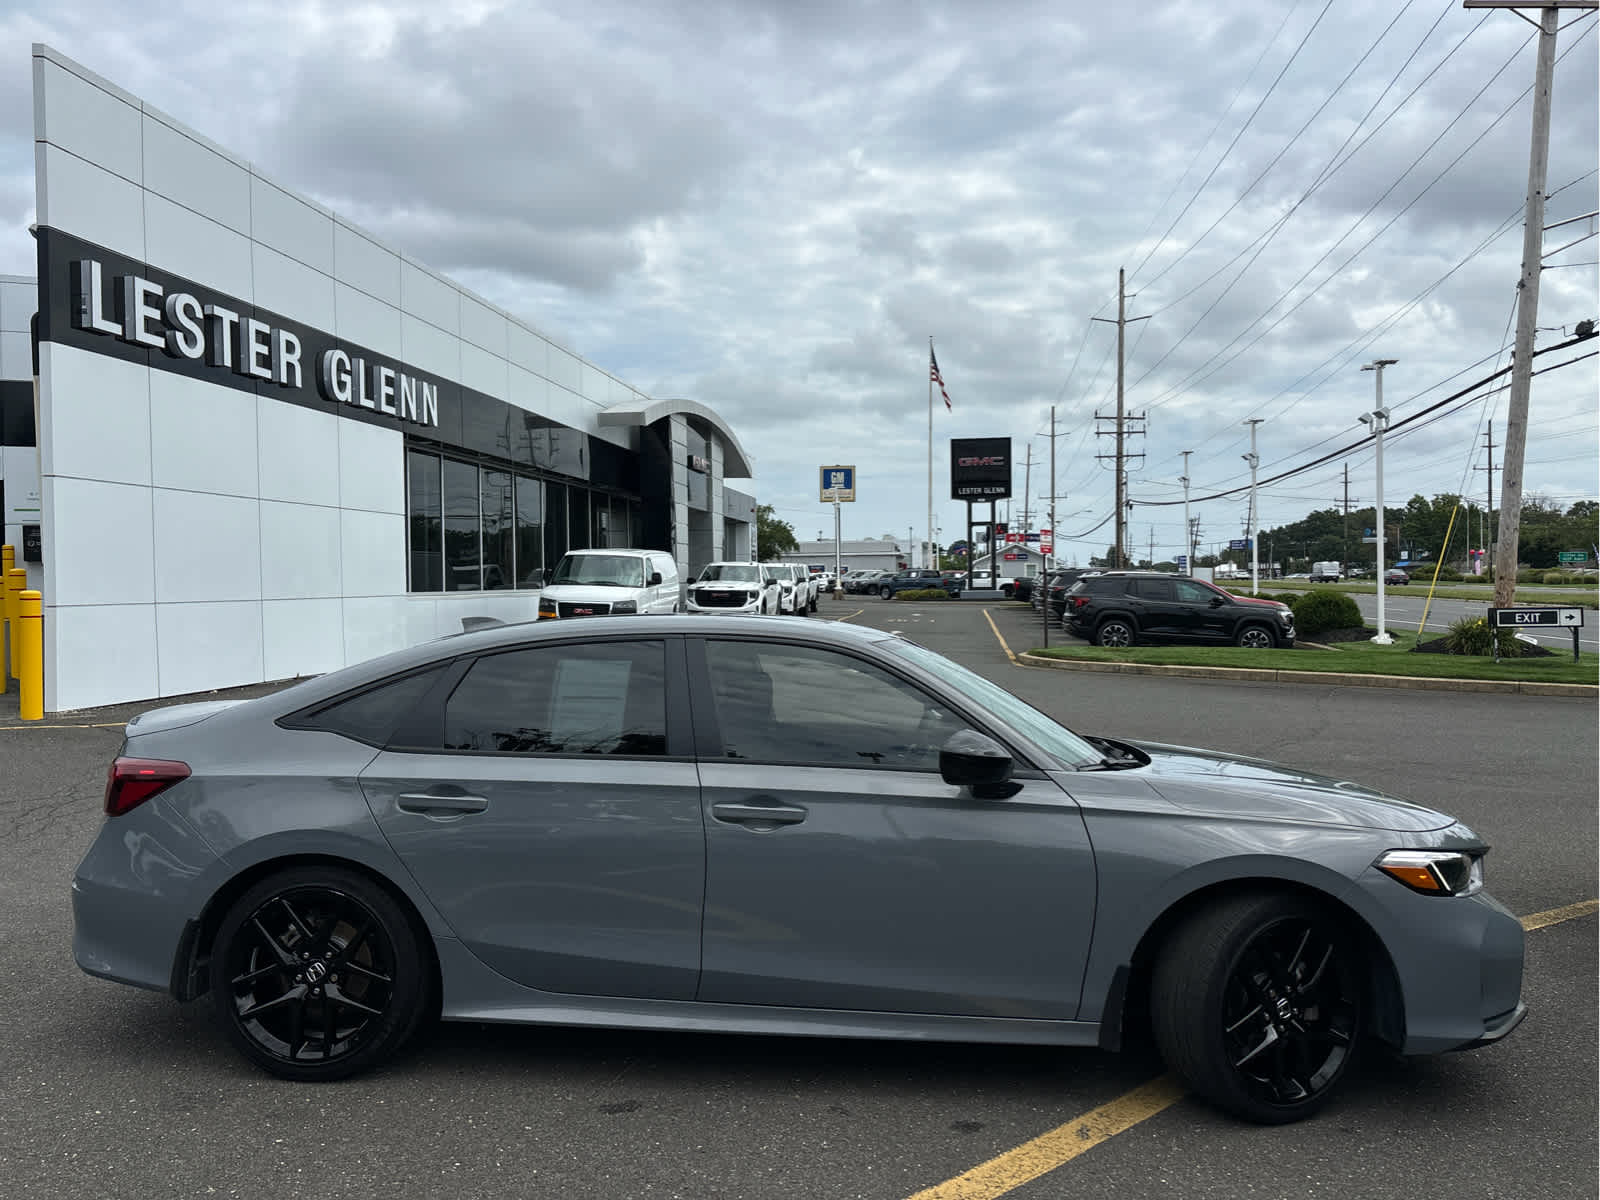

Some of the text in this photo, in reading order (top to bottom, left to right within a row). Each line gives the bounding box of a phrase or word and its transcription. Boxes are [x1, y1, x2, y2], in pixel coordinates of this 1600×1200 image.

[81, 259, 439, 428] LESTER GLENN
[958, 456, 1004, 466] GMC
[958, 486, 1005, 495] LESTER GLENN
[1515, 613, 1541, 623] EXIT
